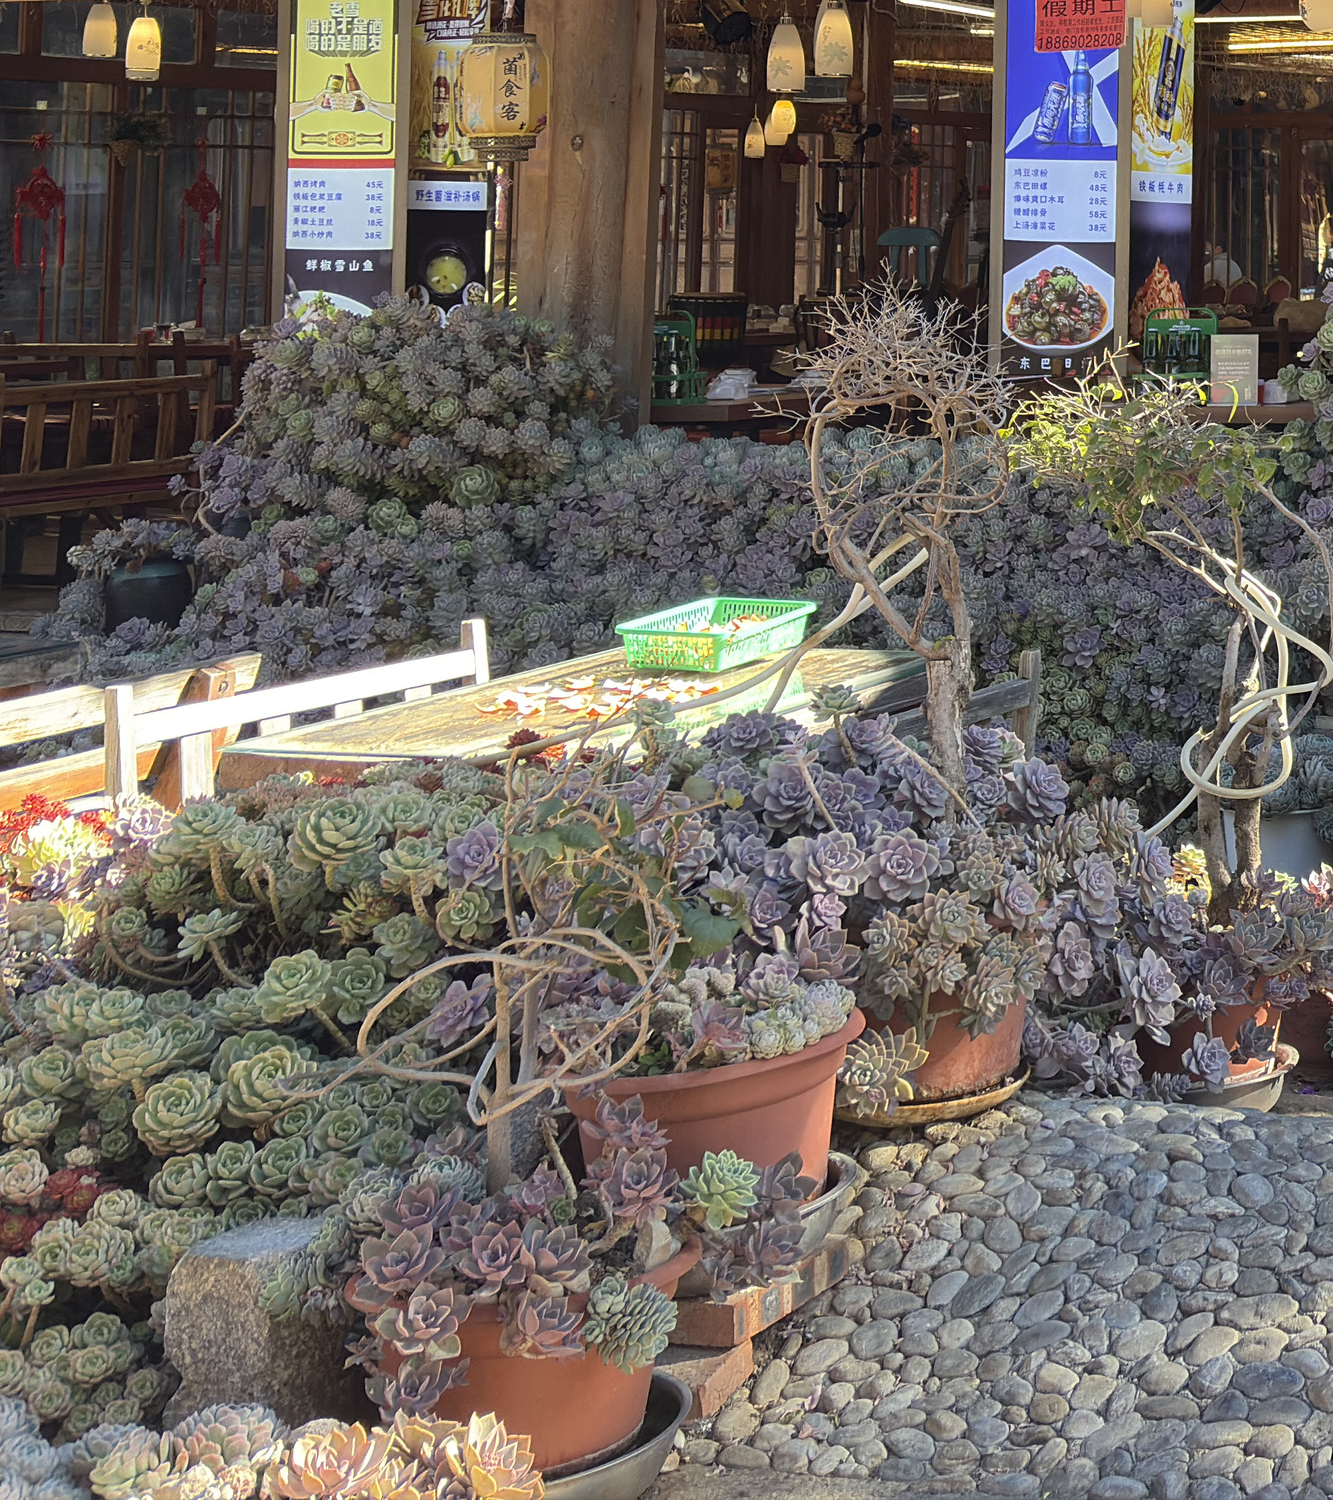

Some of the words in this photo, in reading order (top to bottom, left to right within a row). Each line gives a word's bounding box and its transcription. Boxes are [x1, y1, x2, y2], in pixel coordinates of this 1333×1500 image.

[329, 1, 360, 18] 老雪
[1042, 0, 1122, 17] 假期工
[305, 18, 383, 34] 喝的不是酒
[305, 34, 383, 51] 喝的是朋友
[1038, 33, 1122, 49] 18869028208
[499, 57, 523, 121] 菌食客
[1094, 171, 1107, 179] 8元
[293, 180, 326, 188] 纳西烤肉
[366, 181, 383, 189] 45元
[1014, 181, 1048, 191] 东巴田螺
[1089, 184, 1107, 192] 48元
[1139, 180, 1184, 194] 铁板牦牛肉
[293, 193, 342, 201] 铁板包浆豆腐
[365, 193, 383, 201] 38元
[416, 190, 480, 202] 野生菌滋补汤锅
[1089, 197, 1107, 206] 28元
[293, 205, 326, 214] 丽江粑粑
[369, 206, 382, 214] 8元
[1013, 208, 1047, 217] 糖醋排骨
[1089, 210, 1107, 219] 58元
[293, 218, 334, 226] 青椒土豆丝
[367, 219, 383, 227] 18元
[1088, 224, 1107, 232] 38元
[292, 230, 333, 239] 纳西小炒肉
[365, 231, 382, 239] 38元
[305, 259, 374, 272] 鲜椒雪山鱼
